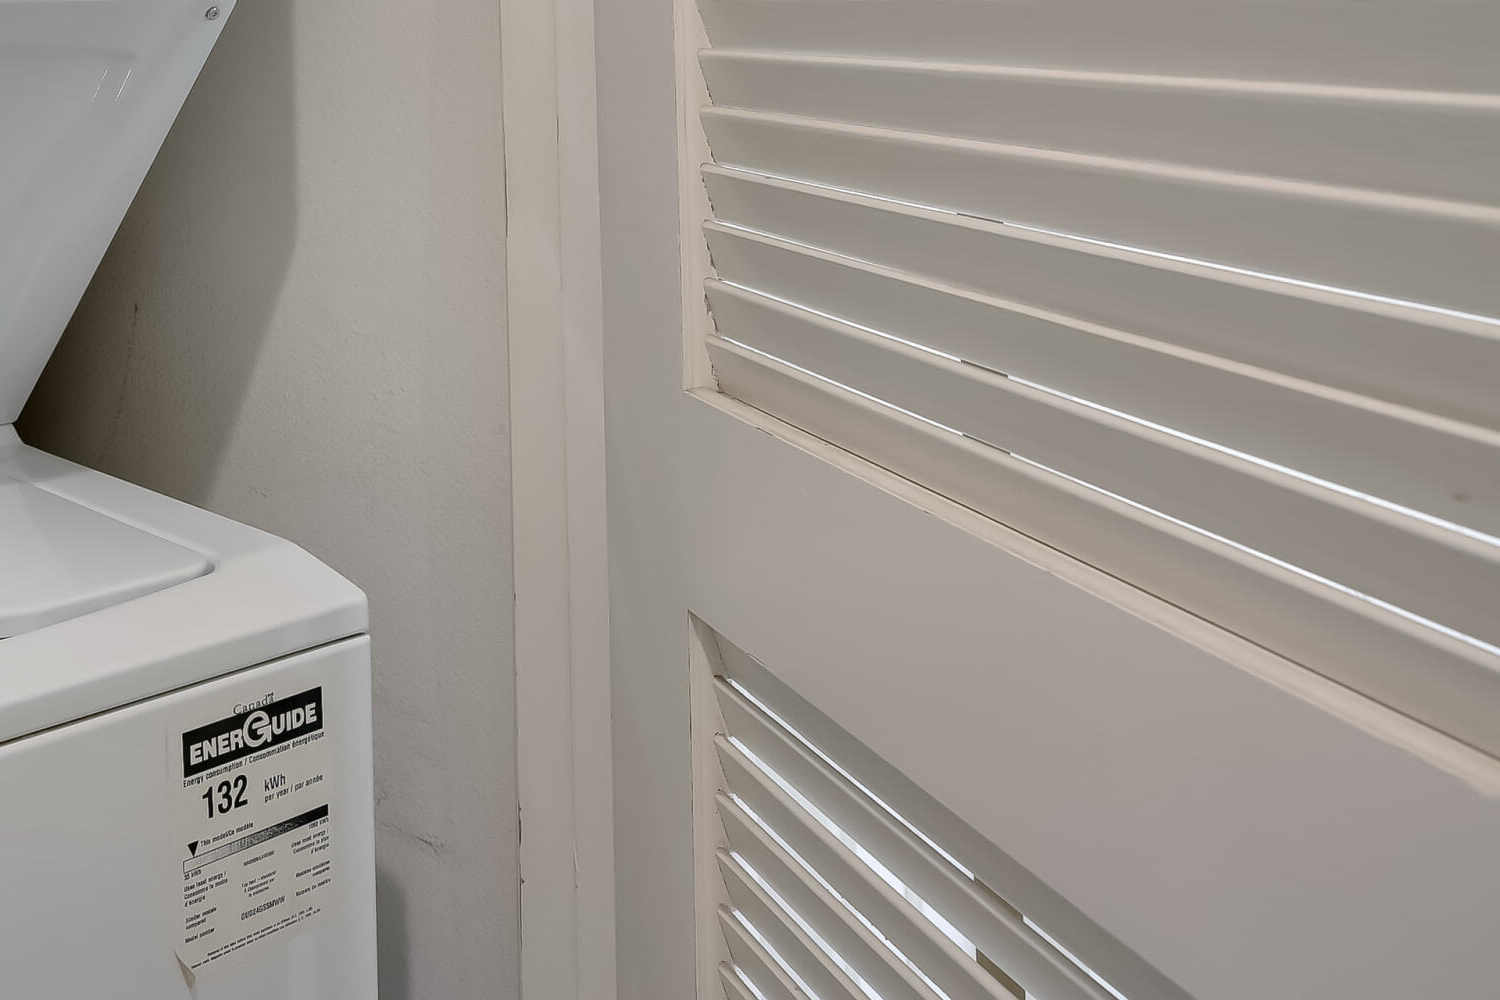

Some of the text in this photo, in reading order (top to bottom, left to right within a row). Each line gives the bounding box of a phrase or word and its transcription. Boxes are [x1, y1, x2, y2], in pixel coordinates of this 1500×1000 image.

[233, 692, 274, 715] Canada
[190, 702, 317, 766] ENERGUIDE
[183, 775, 204, 788] Energy
[206, 761, 243, 779] consumption
[248, 743, 290, 764] Consommation
[202, 774, 248, 818] 132
[264, 774, 286, 792] kWh
[265, 794, 275, 803] per
[276, 787, 290, 799] year
[295, 781, 304, 792] par
[305, 774, 323, 786] année
[200, 838, 211, 847] This
